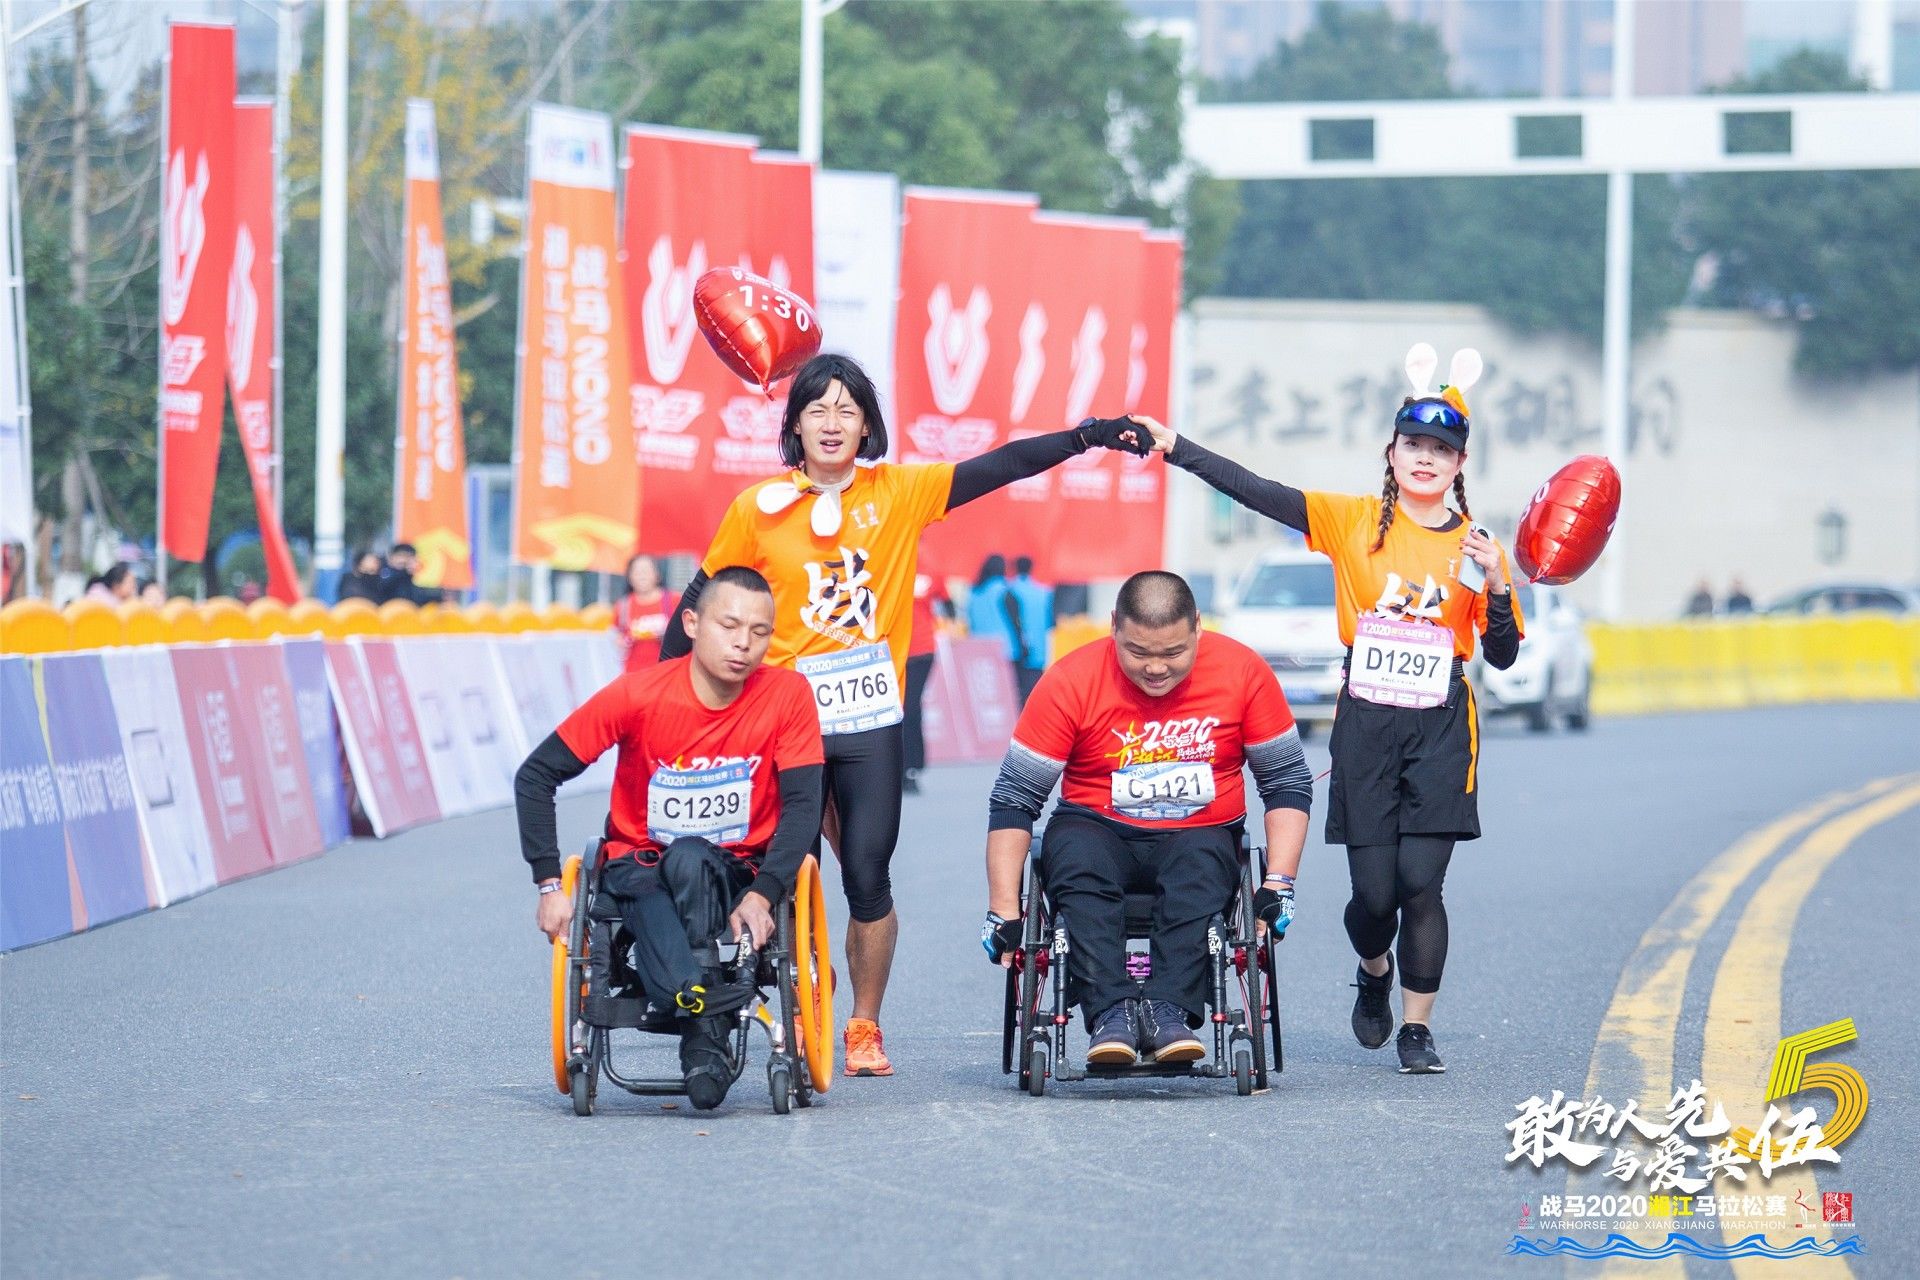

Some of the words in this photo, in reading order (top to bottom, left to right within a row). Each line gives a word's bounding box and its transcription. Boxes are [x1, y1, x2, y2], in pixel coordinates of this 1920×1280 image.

[738, 284, 810, 333] 1:30
[800, 546, 878, 640] 战
[1365, 646, 1441, 679] D1297
[816, 672, 888, 707] C1766
[1127, 772, 1202, 799] C1121
[663, 791, 740, 819] C1239
